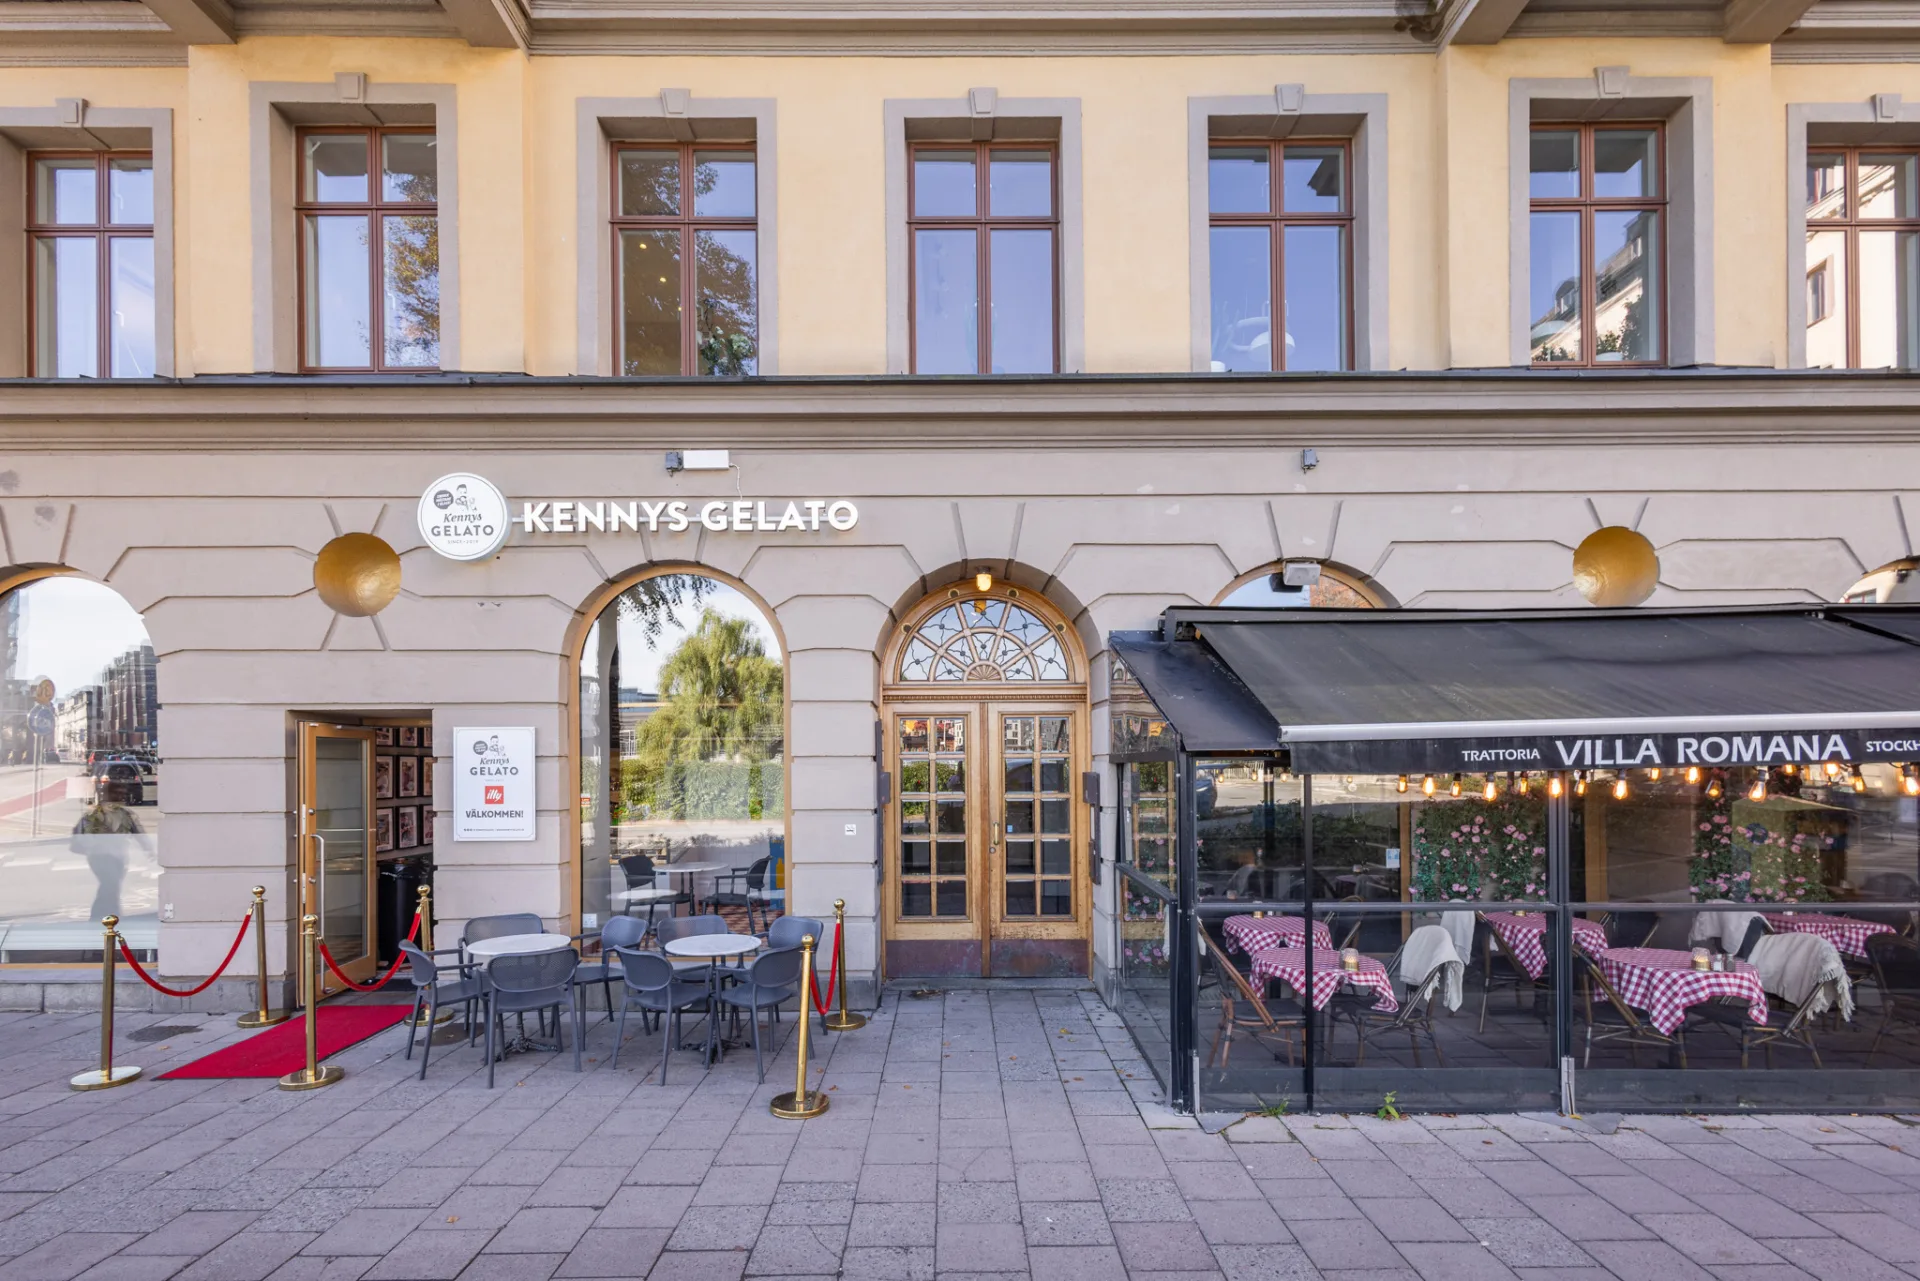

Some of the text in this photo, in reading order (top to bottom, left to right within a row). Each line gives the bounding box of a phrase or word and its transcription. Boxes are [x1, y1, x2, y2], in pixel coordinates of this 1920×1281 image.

[443, 513, 482, 523] Kennys
[524, 500, 859, 533] KENNYS GELATO
[431, 525, 494, 536] GELATO
[1461, 748, 1541, 762] TRATTORIA
[1555, 738, 1661, 766] VILLA
[1677, 734, 1851, 764] ROMANA
[470, 767, 519, 775] GELATO
[486, 789, 502, 803] illy
[465, 809, 524, 818] VÄLKOMMEN!
